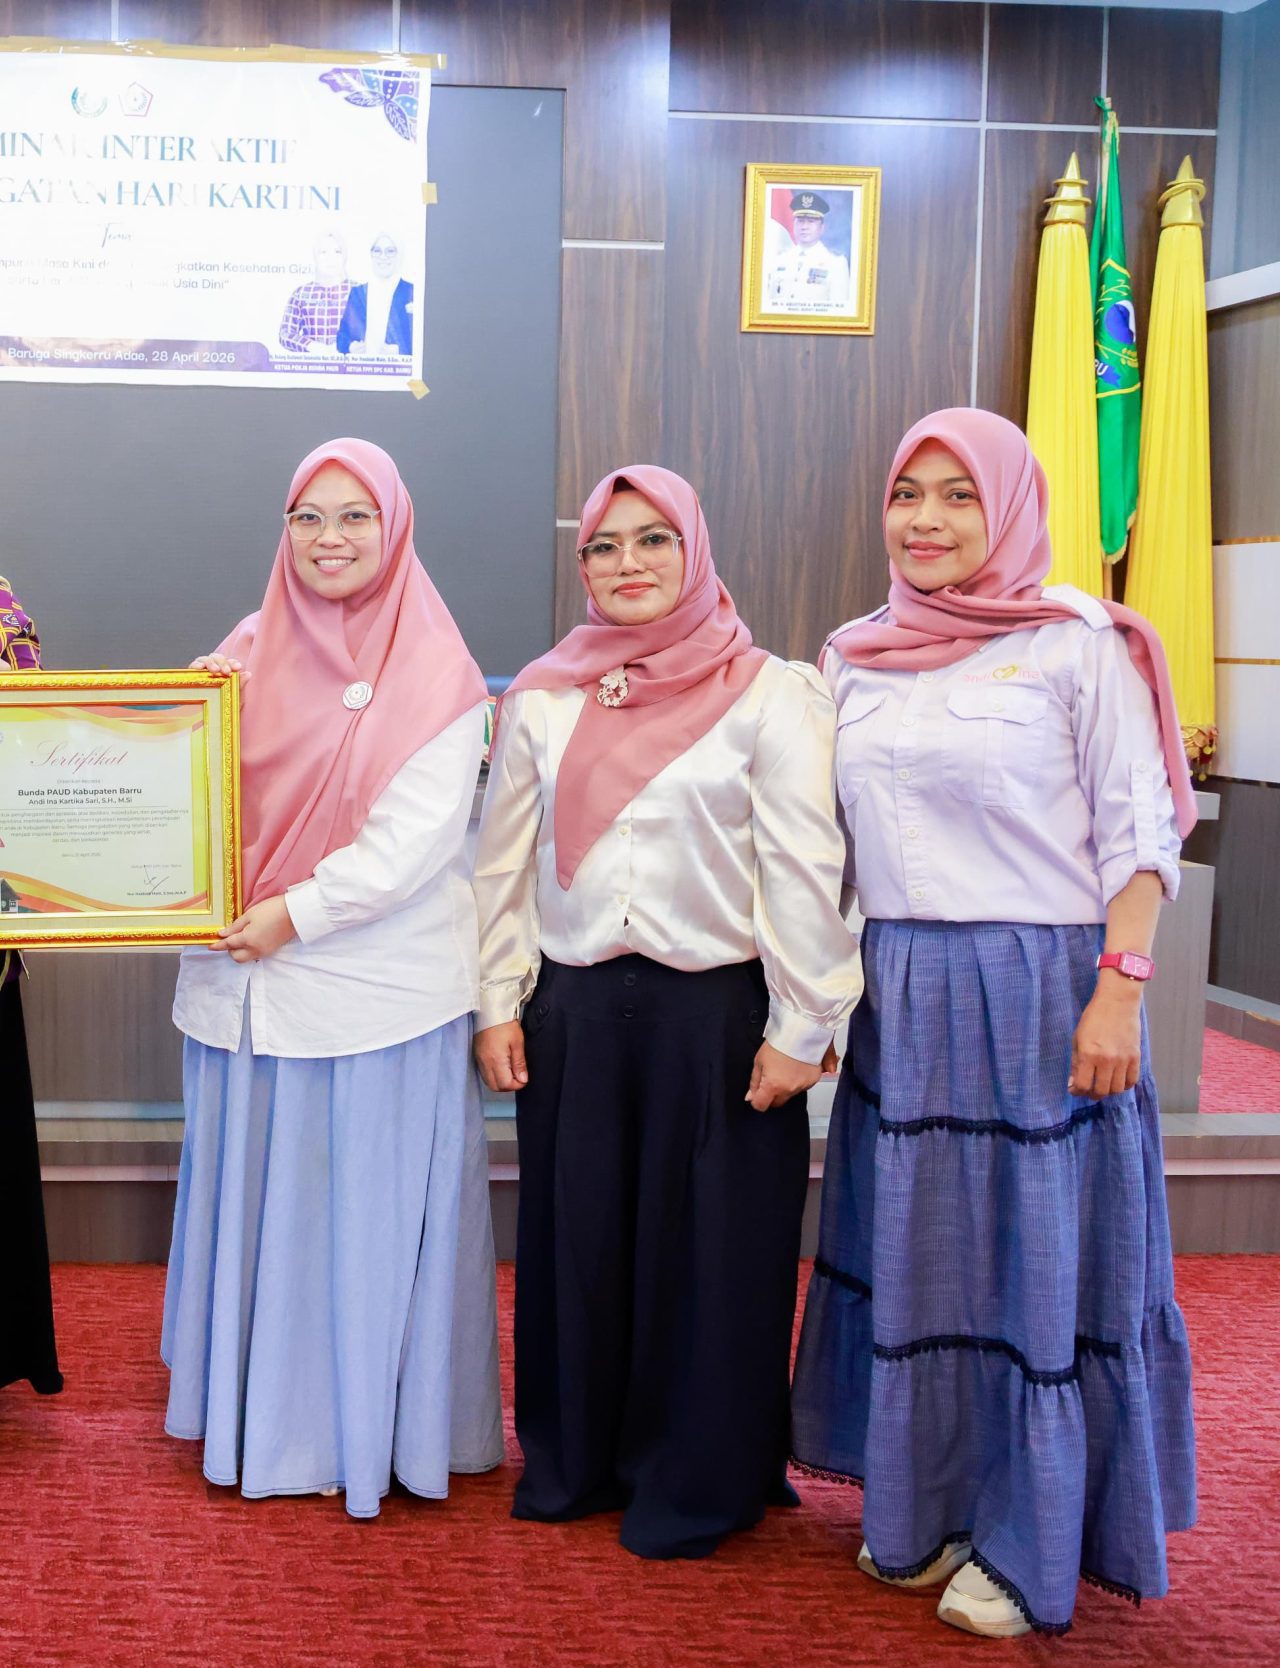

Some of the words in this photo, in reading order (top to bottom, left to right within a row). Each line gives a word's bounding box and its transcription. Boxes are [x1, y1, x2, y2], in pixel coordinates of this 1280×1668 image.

[207, 183, 342, 211] KARTINI
[8, 348, 49, 362] Baruga
[152, 350, 168, 361] 28
[172, 351, 199, 364] April
[203, 352, 236, 364] 2026
[73, 788, 117, 797] Kabupaten
